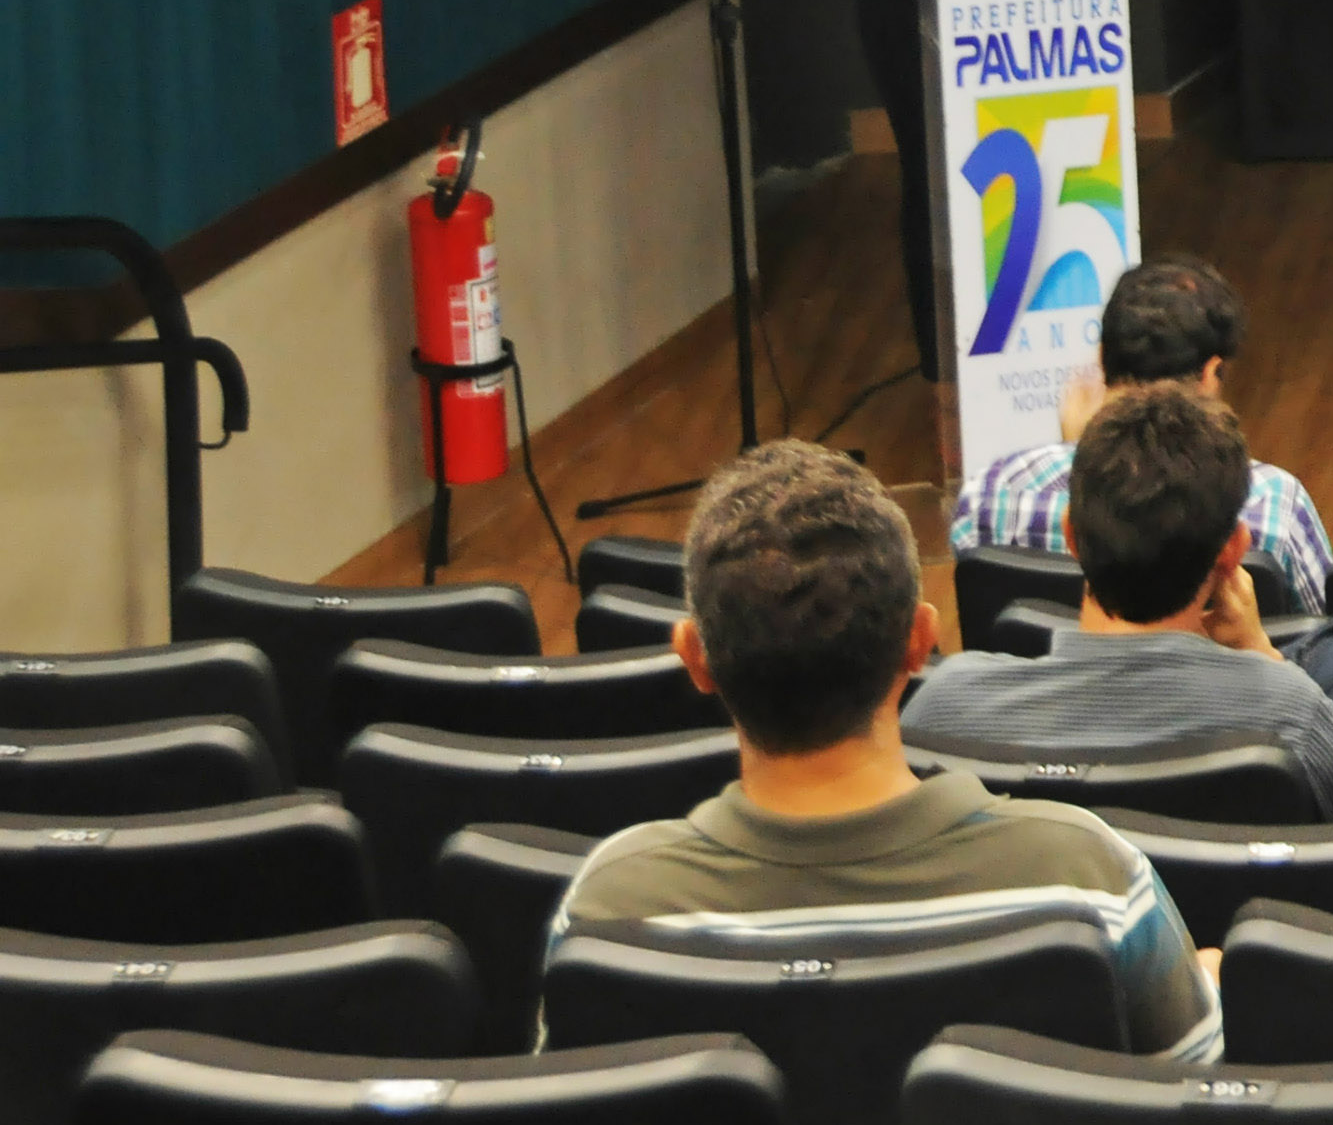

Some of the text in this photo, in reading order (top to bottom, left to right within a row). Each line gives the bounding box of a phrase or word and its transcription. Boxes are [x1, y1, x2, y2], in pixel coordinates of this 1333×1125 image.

[954, 22, 1125, 87] PALMAS
[961, 114, 1129, 357] 25
[1018, 319, 1103, 352] ANO
[999, 368, 1050, 392] NOVOS
